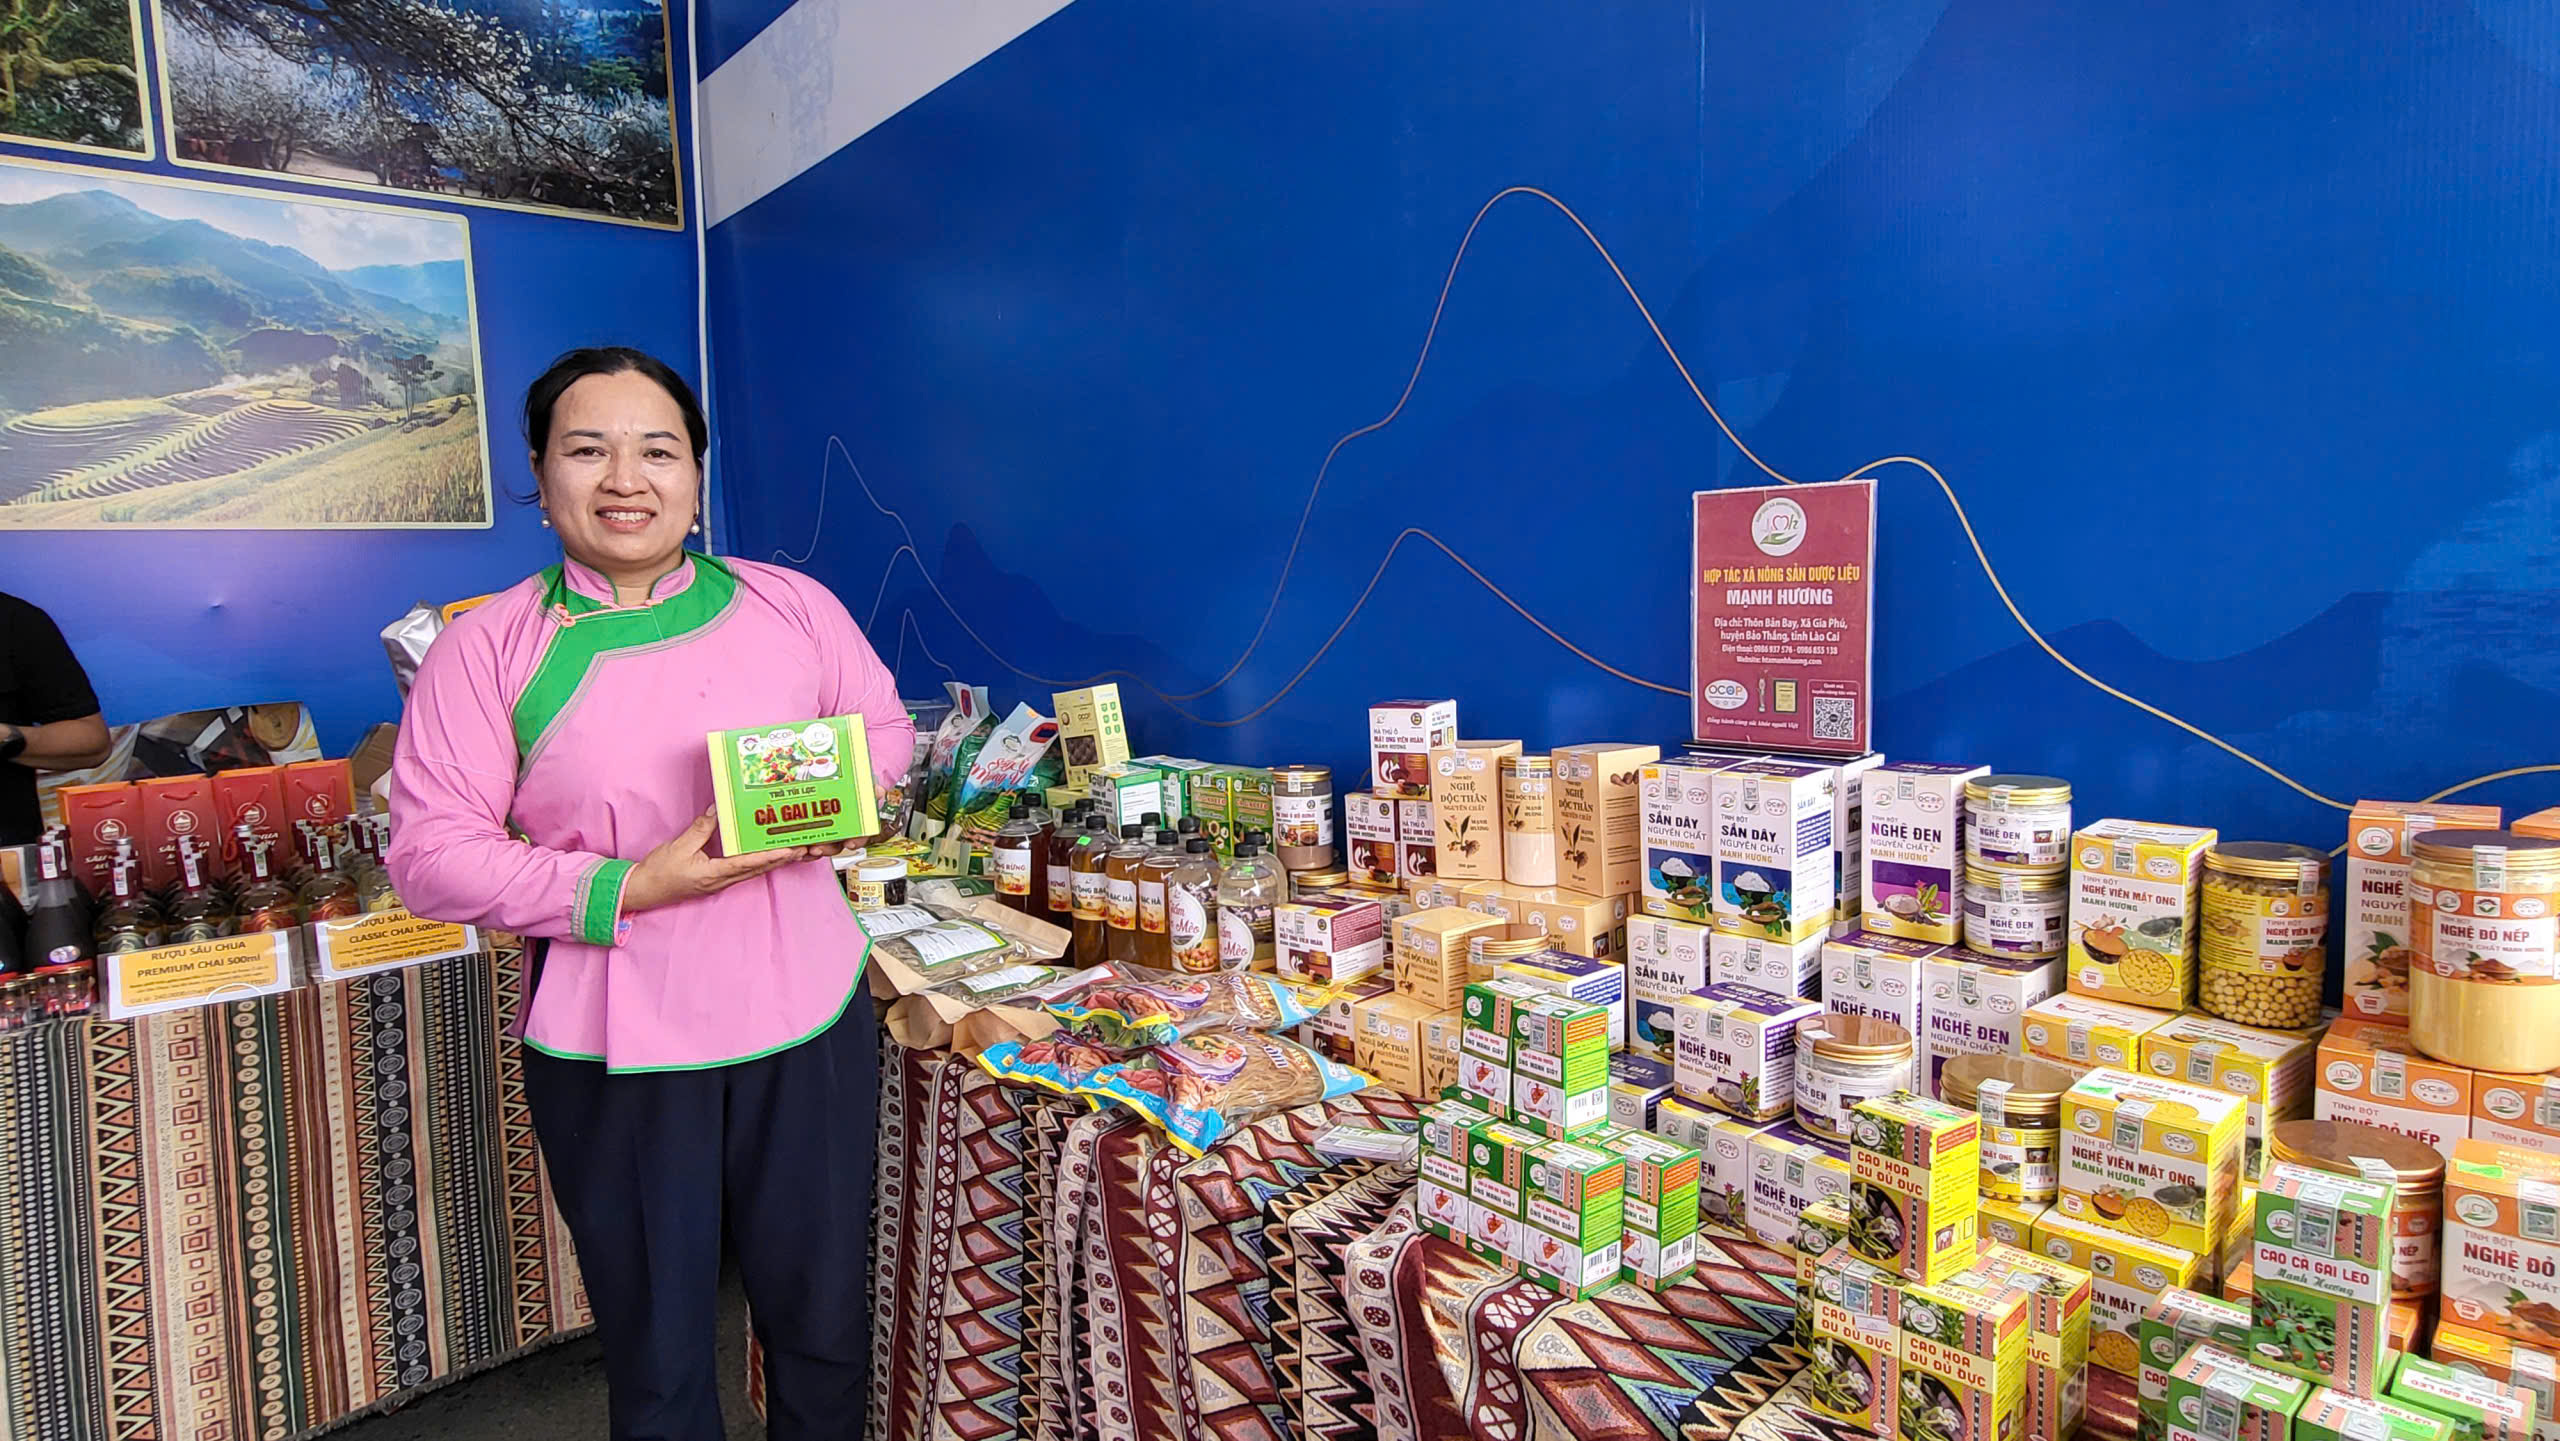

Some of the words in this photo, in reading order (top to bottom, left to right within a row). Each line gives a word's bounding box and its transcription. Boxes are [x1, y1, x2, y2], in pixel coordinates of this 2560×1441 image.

[1703, 569, 1721, 586] HỢP
[1723, 567, 1741, 583] TÁC
[1743, 566, 1755, 583] XÃ
[1757, 565, 1784, 582] NÔNG
[1786, 563, 1806, 582] SẢN
[1808, 566, 1836, 584] DƯỢC
[1837, 563, 1860, 584] LIỆU
[1726, 589, 1773, 608] MẠNH
[1777, 587, 1833, 605] HƯƠNG
[1714, 617, 1728, 629] Địa
[1728, 617, 1743, 627] chỉ:
[1744, 617, 1763, 628] Thôn
[1765, 616, 1780, 628] Bản
[1782, 618, 1799, 630] Bay,
[1800, 617, 1812, 628] Xã
[1814, 617, 1827, 628] Gia
[1828, 617, 1848, 630] Phú,
[1720, 630, 1745, 643] huyện
[1746, 629, 1761, 641] Bảo
[1762, 629, 1790, 643] Thắng,
[1791, 630, 1808, 641] tỉnh
[1809, 631, 1825, 642] Lào
[1826, 631, 1840, 642] Cai
[1721, 643, 1735, 654] Điện
[1736, 655, 1761, 664] Website:
[1450, 782, 1476, 793] NGHỆ
[754, 804, 779, 826] CÀ
[780, 801, 809, 822] GAI
[812, 798, 841, 817] LEO
[1675, 816, 1698, 829] DÂY
[1648, 826, 1681, 837] NGUYÊN
[1683, 830, 1707, 841] CHẤT
[1751, 828, 1776, 843] DÂY
[1871, 822, 1908, 842] NGHỆ
[1913, 827, 1942, 843] ĐEN
[1720, 838, 1757, 851] NGUYÊN
[1760, 844, 1785, 855] CHẤT
[1870, 838, 1903, 849] NGUYÊN
[1906, 842, 1928, 852] CHẤT
[1005, 862, 1026, 872] RỪNG
[2081, 884, 2107, 897] NGHỆ
[2108, 887, 2130, 899] VIÊN
[2132, 891, 2153, 904] MẬT
[2155, 896, 2177, 906] ONG
[2361, 880, 2404, 898] NGHỆ
[349, 930, 389, 944] CLASSIC
[390, 927, 414, 937] CHAI
[416, 921, 446, 933] 500ml
[2440, 923, 2475, 941] NGHỆ
[2478, 926, 2498, 941] ĐỎ
[2503, 928, 2530, 942] NẾP
[151, 947, 187, 961] RƯỢU
[215, 941, 247, 951] CHUA
[137, 963, 195, 978] PREMIUM
[197, 959, 225, 970] CHAI
[227, 953, 261, 966] 500ml
[1634, 978, 1668, 992] NGUYÊN
[1662, 971, 1685, 985] DÂY
[1931, 1014, 1972, 1040] NGHỆ
[1977, 1025, 2010, 1045] ĐEN
[1930, 1031, 1967, 1047] NGUYÊN
[1969, 1039, 1994, 1053] CHẤT
[1679, 1038, 1707, 1061] NGHỆ
[1709, 1048, 1731, 1067] ĐEN
[2332, 1101, 2356, 1112] TINH
[2359, 1106, 2380, 1117] BỘT
[2071, 1134, 2095, 1146] TINH
[2490, 1131, 2518, 1143] TINH
[2521, 1136, 2544, 1149] BỘT
[1701, 1160, 1715, 1177] EN
[1857, 1151, 1881, 1168] CAO
[1884, 1160, 1910, 1177] HOA
[2071, 1145, 2103, 1166] NGHỆ
[2106, 1154, 2134, 1172] VIÊN
[2138, 1162, 2165, 1180] MẬT
[2168, 1170, 2196, 1187] ONG
[1856, 1164, 1873, 1178] ĐU
[1876, 1171, 1893, 1186] ĐỦ
[1896, 1178, 1923, 1196] ĐỰC
[2106, 1169, 2146, 1187] HƯƠNG
[1754, 1179, 1786, 1207] NGHỆ
[1753, 1195, 1782, 1212] NGUYÊN
[2464, 1230, 2489, 1242] TINH
[2492, 1235, 2514, 1248] BỘT
[2260, 1247, 2287, 1265] CAO
[2291, 1254, 2310, 1271] CÀ
[2314, 1261, 2338, 1278] GAI
[2342, 1268, 2370, 1285] LEO
[2463, 1241, 2520, 1273] NGHỆ
[2526, 1255, 2556, 1278] ĐỎ
[2462, 1264, 2518, 1285] NGUYÊN
[2521, 1279, 2558, 1294] CHẤT
[1821, 1305, 1847, 1322] CAO
[2109, 1295, 2137, 1315] MẬT
[1821, 1318, 1839, 1333] ĐU
[1865, 1335, 1893, 1352] ĐỰC
[1910, 1337, 1937, 1355] CAO
[1942, 1349, 1971, 1368] HOA
[2204, 1347, 2227, 1360] CAO
[1909, 1350, 1928, 1366] ĐU
[1933, 1360, 1952, 1375] ĐỦ
[1957, 1368, 1987, 1387] ĐỰC
[2144, 1370, 2168, 1387] CAO
